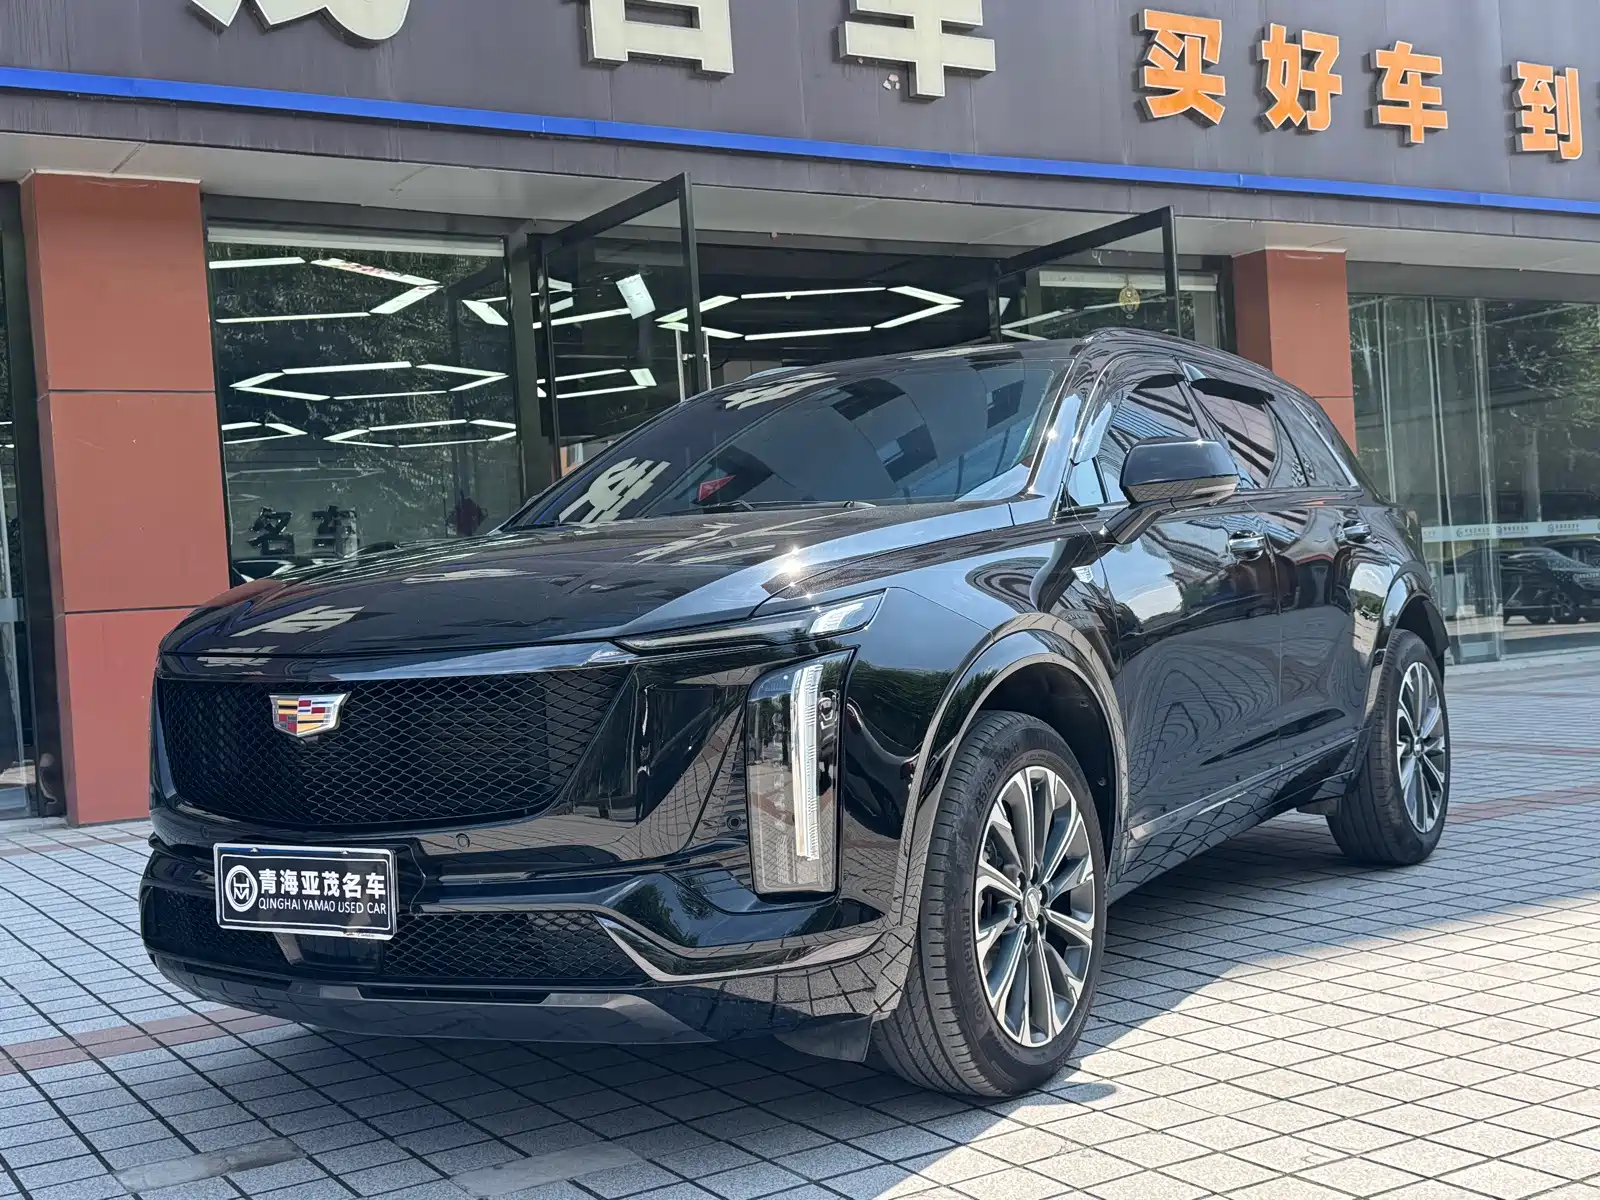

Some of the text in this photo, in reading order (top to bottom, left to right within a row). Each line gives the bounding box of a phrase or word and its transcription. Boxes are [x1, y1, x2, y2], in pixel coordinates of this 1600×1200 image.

[258, 868, 386, 899] 青海亚茂名车
[258, 897, 387, 915] QINGHAI YAMAO USED CAR
